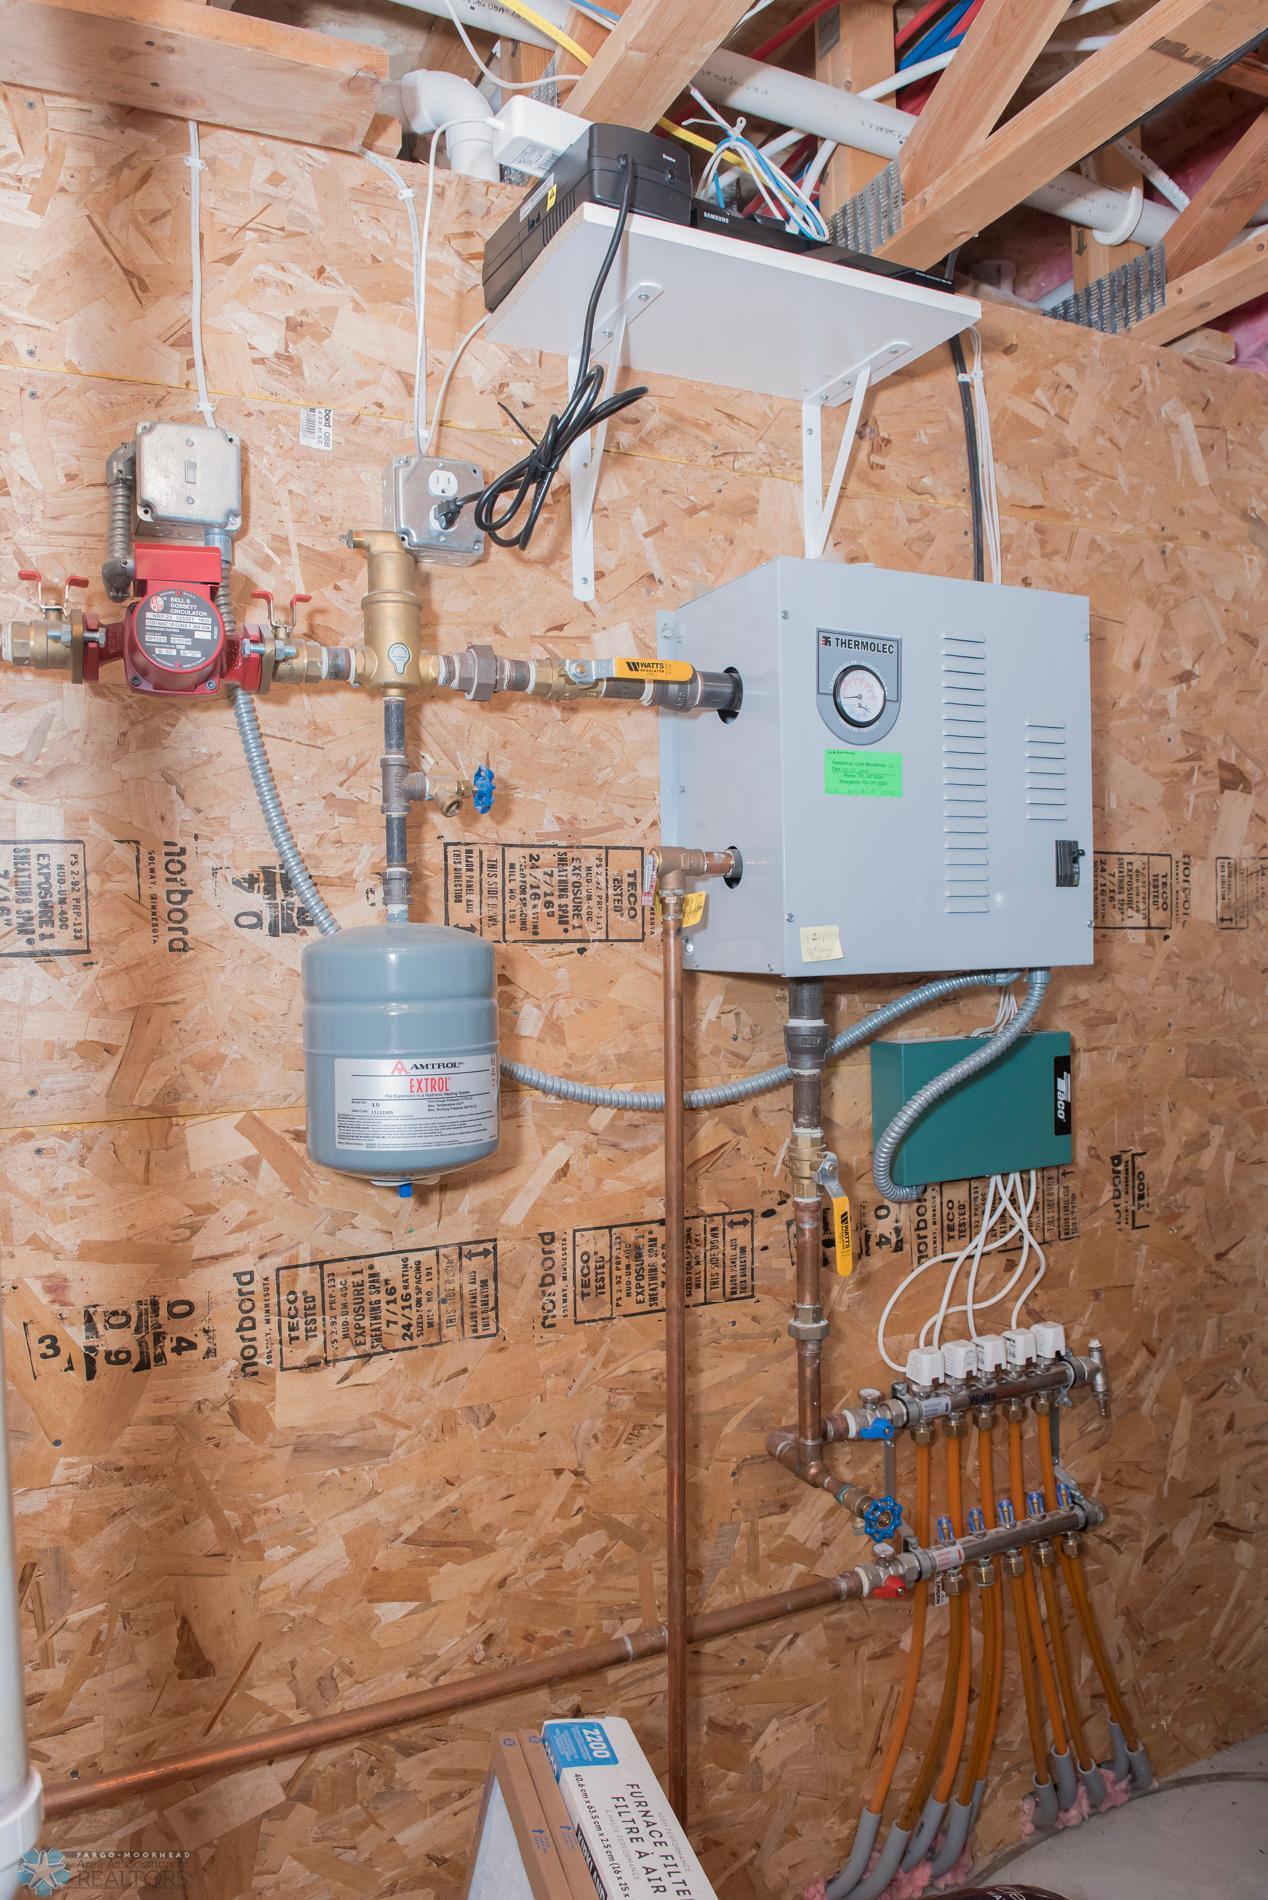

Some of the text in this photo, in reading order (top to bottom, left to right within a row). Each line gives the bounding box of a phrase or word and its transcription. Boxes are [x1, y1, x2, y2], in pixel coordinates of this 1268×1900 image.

[703, 212, 729, 224] SAMSUNG
[170, 608, 208, 617] CIRCULATOR
[835, 637, 894, 654] THERMOLEC
[465, 849, 474, 872] MAJOR
[487, 858, 497, 878] THIS
[508, 863, 516, 883] MILL
[529, 853, 541, 901] 24/16
[1099, 859, 1107, 897] 24/16
[37, 854, 54, 928] EXPOSURE
[70, 854, 82, 940] PS 2-92 PRP-133
[164, 841, 193, 952] norbord
[466, 876, 474, 896] PANEL
[572, 857, 583, 921] EXPOSURE
[627, 870, 638, 919] TECO
[1126, 862, 1134, 911] EXPOSURE
[1161, 872, 1169, 912] TECO
[409, 1076, 450, 1093] EXTROL
[410, 1062, 459, 1070] AMTROL
[1056, 1071, 1071, 1119] Taco
[947, 1200, 955, 1242] TECO
[425, 1266, 433, 1282] 191
[580, 1251, 591, 1301] TECO
[634, 1244, 645, 1305] EXPOSURE
[709, 1226, 720, 1291] THIS SIDE DOWN
[414, 1260, 422, 1297] SPACING
[648, 1263, 658, 1307] SHEATHING
[263, 1276, 271, 1324] MINNESOTA
[327, 1272, 338, 1336] 2-92 PRP-133
[351, 1268, 366, 1347] EXPOSURE 1
[368, 1272, 383, 1349] SHEATHING SPAN
[384, 1278, 398, 1328] 7/16"
[401, 1257, 413, 1341] 24/16 RATING
[469, 1287, 477, 1308] PANEL
[615, 1296, 622, 1308] PS
[233, 1270, 259, 1377] norbord
[286, 1290, 300, 1345] TECO
[416, 1314, 424, 1337] SIZED
[446, 1308, 457, 1329] THIS
[37, 1334, 62, 1360] 3
[583, 1728, 611, 1759] 2200
[574, 1773, 584, 1787] 40.6
[580, 1788, 589, 1799] cm
[586, 1805, 599, 1821] 63.5
[593, 1820, 602, 1832] cm
[600, 1837, 611, 1850] 2.5
[606, 1851, 616, 1862] cm
[611, 1796, 645, 1843] FILTRE
[642, 1865, 667, 1894] AIR
[626, 1783, 694, 1900] FURNACE FILTE
[609, 1861, 620, 1875] (16
[619, 1882, 630, 1893] 25
